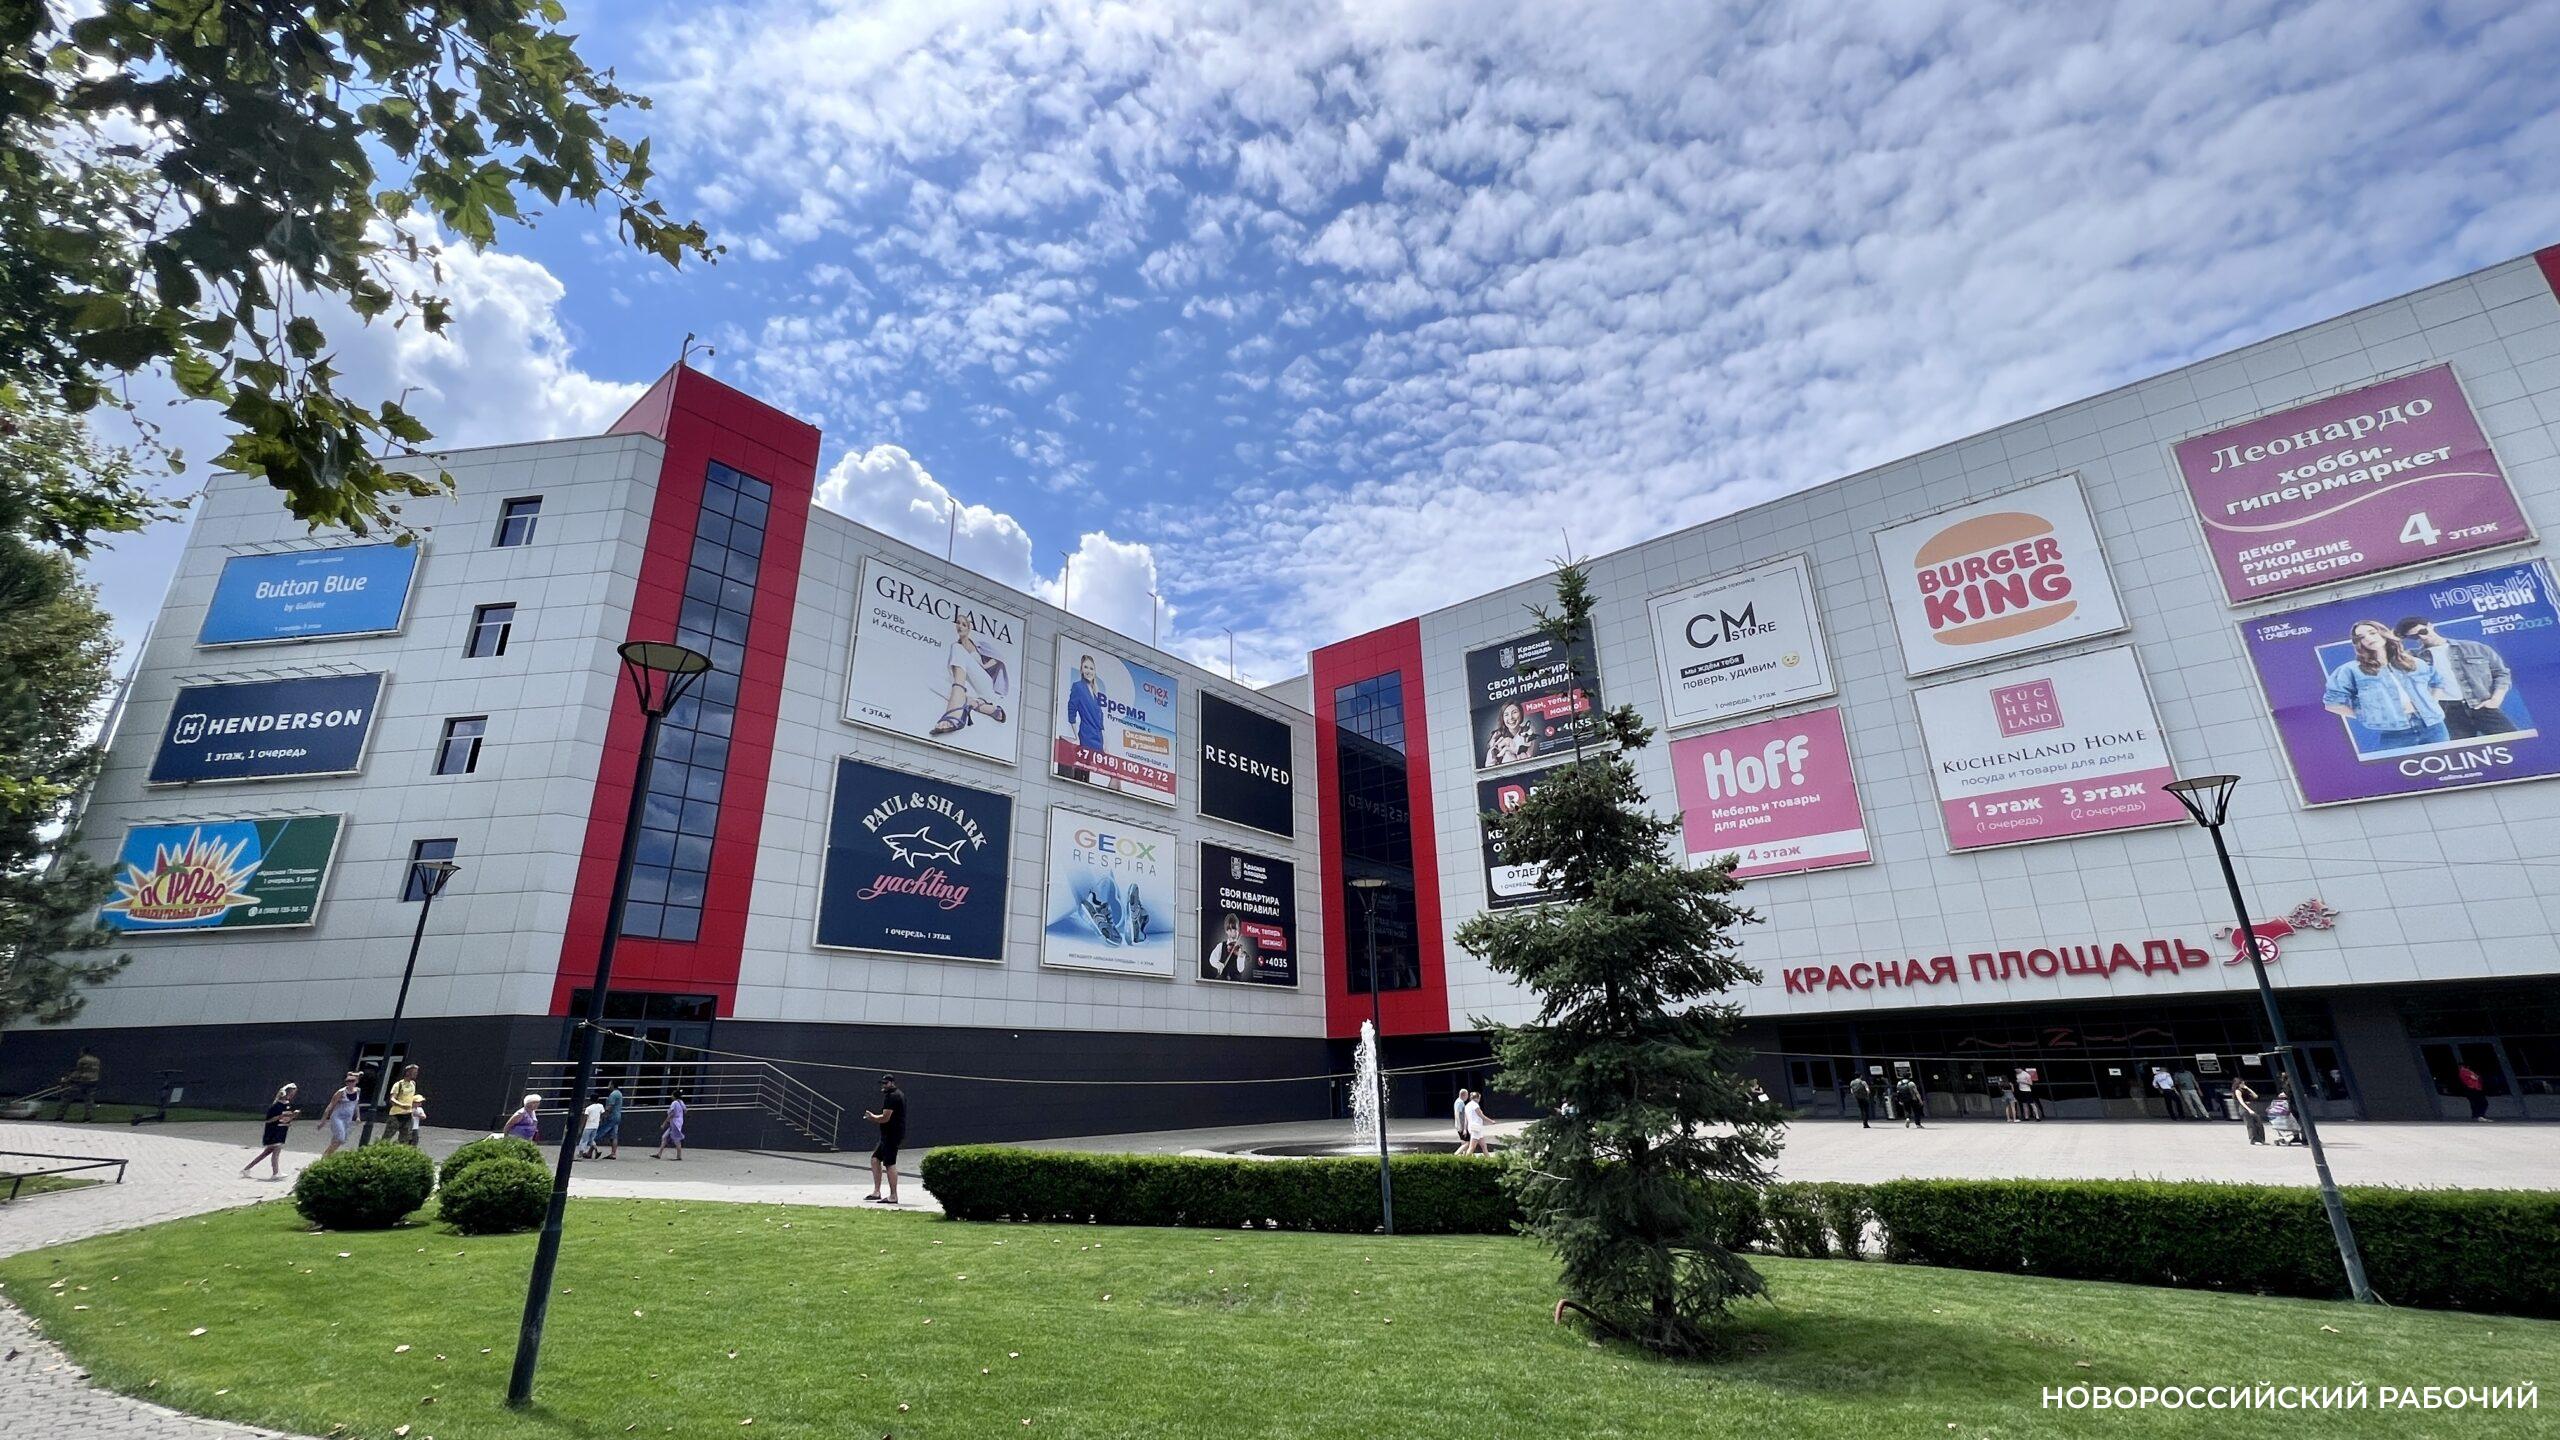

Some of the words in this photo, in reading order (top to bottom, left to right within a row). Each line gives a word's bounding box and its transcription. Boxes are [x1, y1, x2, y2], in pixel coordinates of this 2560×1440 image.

[2210, 397, 2434, 474] Леонардо
[2278, 444, 2393, 485] хобби-
[2225, 446, 2451, 517] гипермаркет
[2399, 511, 2442, 546] 4
[2448, 522, 2499, 540] этаж
[2238, 539, 2297, 563] ДЕКОР
[2242, 540, 2352, 574] РУКОДЕЛИЕ
[1917, 537, 2063, 595] BURGER
[2246, 552, 2364, 587] ТВОРЧЕСТВО
[255, 580, 320, 599] Button
[323, 575, 368, 593] Blue
[1923, 563, 2073, 630] KING
[2429, 569, 2537, 609] НОВЫЙ
[873, 606, 905, 625] ОБУВЬ
[876, 575, 1014, 645] GRACIANA
[2480, 613, 2524, 627] ВЕСНА
[872, 617, 879, 627] И
[880, 620, 942, 648] АКСЕССУАРЫ
[1685, 601, 1757, 649] CM
[1731, 621, 1777, 642] STORE
[2262, 622, 2291, 634] ЭТАЖ
[2265, 626, 2312, 641] ОЧЕРЕДЬ
[2481, 623, 2515, 635] ЛЕТО
[1517, 640, 1550, 654] Красная
[1487, 676, 1515, 691] СВОЯ
[1488, 687, 1518, 701] СВОИ
[1519, 672, 1574, 693] ПРАВИЛА!
[1682, 673, 1728, 691] поверь,
[1729, 661, 1777, 680] удивим
[1142, 682, 1169, 700] anex
[2001, 687, 2045, 705] KÜC
[868, 708, 892, 721] ЭТАЖ
[1097, 691, 1146, 722] Время
[2004, 700, 2048, 716] HEN
[207, 709, 362, 736] HENDERSON
[2008, 713, 2053, 730] LAND
[205, 751, 213, 762] 1
[214, 749, 245, 762] этаж,
[248, 749, 255, 759] 1
[257, 747, 307, 760] очередь
[1076, 749, 1089, 760] +7
[1092, 752, 1119, 770] (918)
[1122, 761, 1140, 774] 100
[1142, 766, 1154, 778] 72
[1156, 770, 1169, 783] 72
[1205, 744, 1289, 785] RESERVED
[1703, 734, 1810, 801] Hoff
[2399, 745, 2513, 777] COLIN'S
[1961, 773, 2005, 787] посуда
[2009, 770, 2017, 779] и
[2018, 762, 2068, 779] товары
[2070, 759, 2096, 771] для
[2099, 751, 2135, 766] дома
[1711, 802, 1760, 820] Мебель
[1760, 801, 1770, 812] и
[1772, 792, 1821, 812] товары
[1968, 801, 1980, 818] 1
[1984, 796, 2044, 816] этаж
[2060, 787, 2077, 805] 3
[2081, 781, 2147, 803] этаж
[861, 794, 908, 834] PAUL
[909, 791, 925, 809] &
[926, 793, 988, 852] SHARK
[1713, 818, 1737, 833] для
[1738, 814, 1772, 830] дома
[1976, 821, 1986, 833] (1
[1988, 814, 2044, 830] очередь)
[2071, 808, 2084, 821] (2
[2087, 800, 2147, 818] очередь)
[1074, 829, 1156, 862] GEOX
[1747, 847, 1758, 861] 4
[1762, 844, 1802, 860] этаж
[1073, 849, 1158, 878] RESPIRA
[856, 866, 970, 910] yachting
[1220, 887, 1241, 900] СВОЯ
[1242, 891, 1280, 906] КВАРТИРА
[1220, 898, 1242, 911] СВОИ
[1243, 902, 1280, 917] ПРАВИЛА!
[890, 928, 926, 939] очередь,
[1783, 955, 1958, 994] КРАСНАЯ
[1968, 938, 2210, 981] ПЛОЩАДЬ
